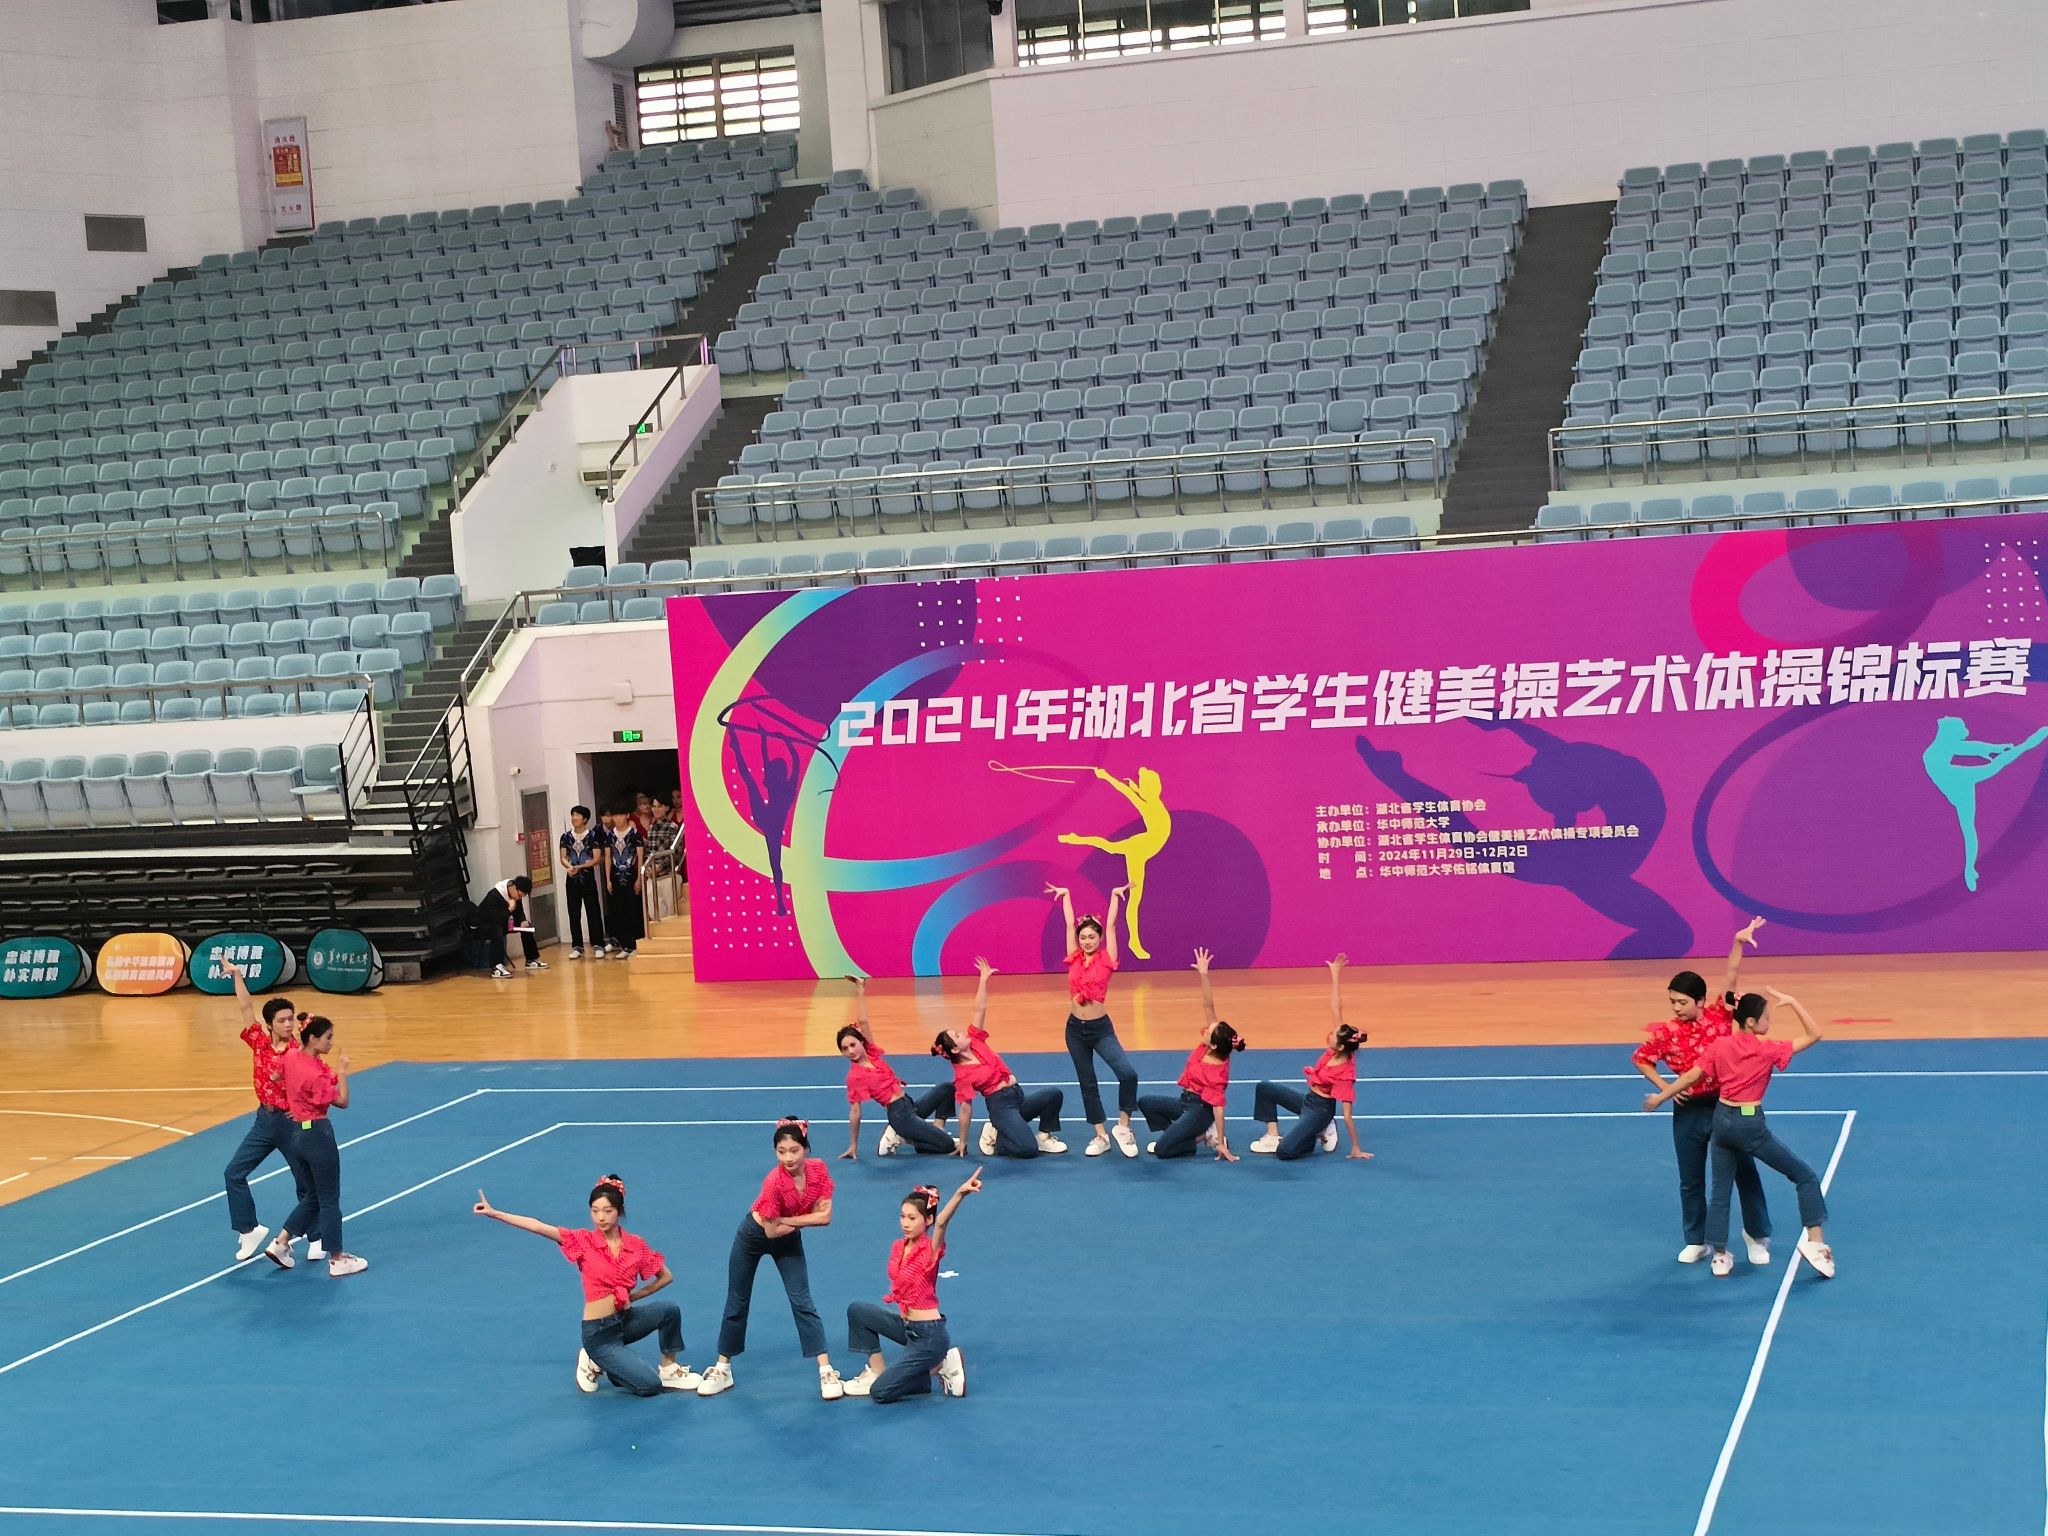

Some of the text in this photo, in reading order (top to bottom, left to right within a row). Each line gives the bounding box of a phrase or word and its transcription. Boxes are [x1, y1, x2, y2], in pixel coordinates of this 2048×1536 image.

[837, 637, 2033, 747] 2024年湖北省学生健美操艺术体操锦标赛
